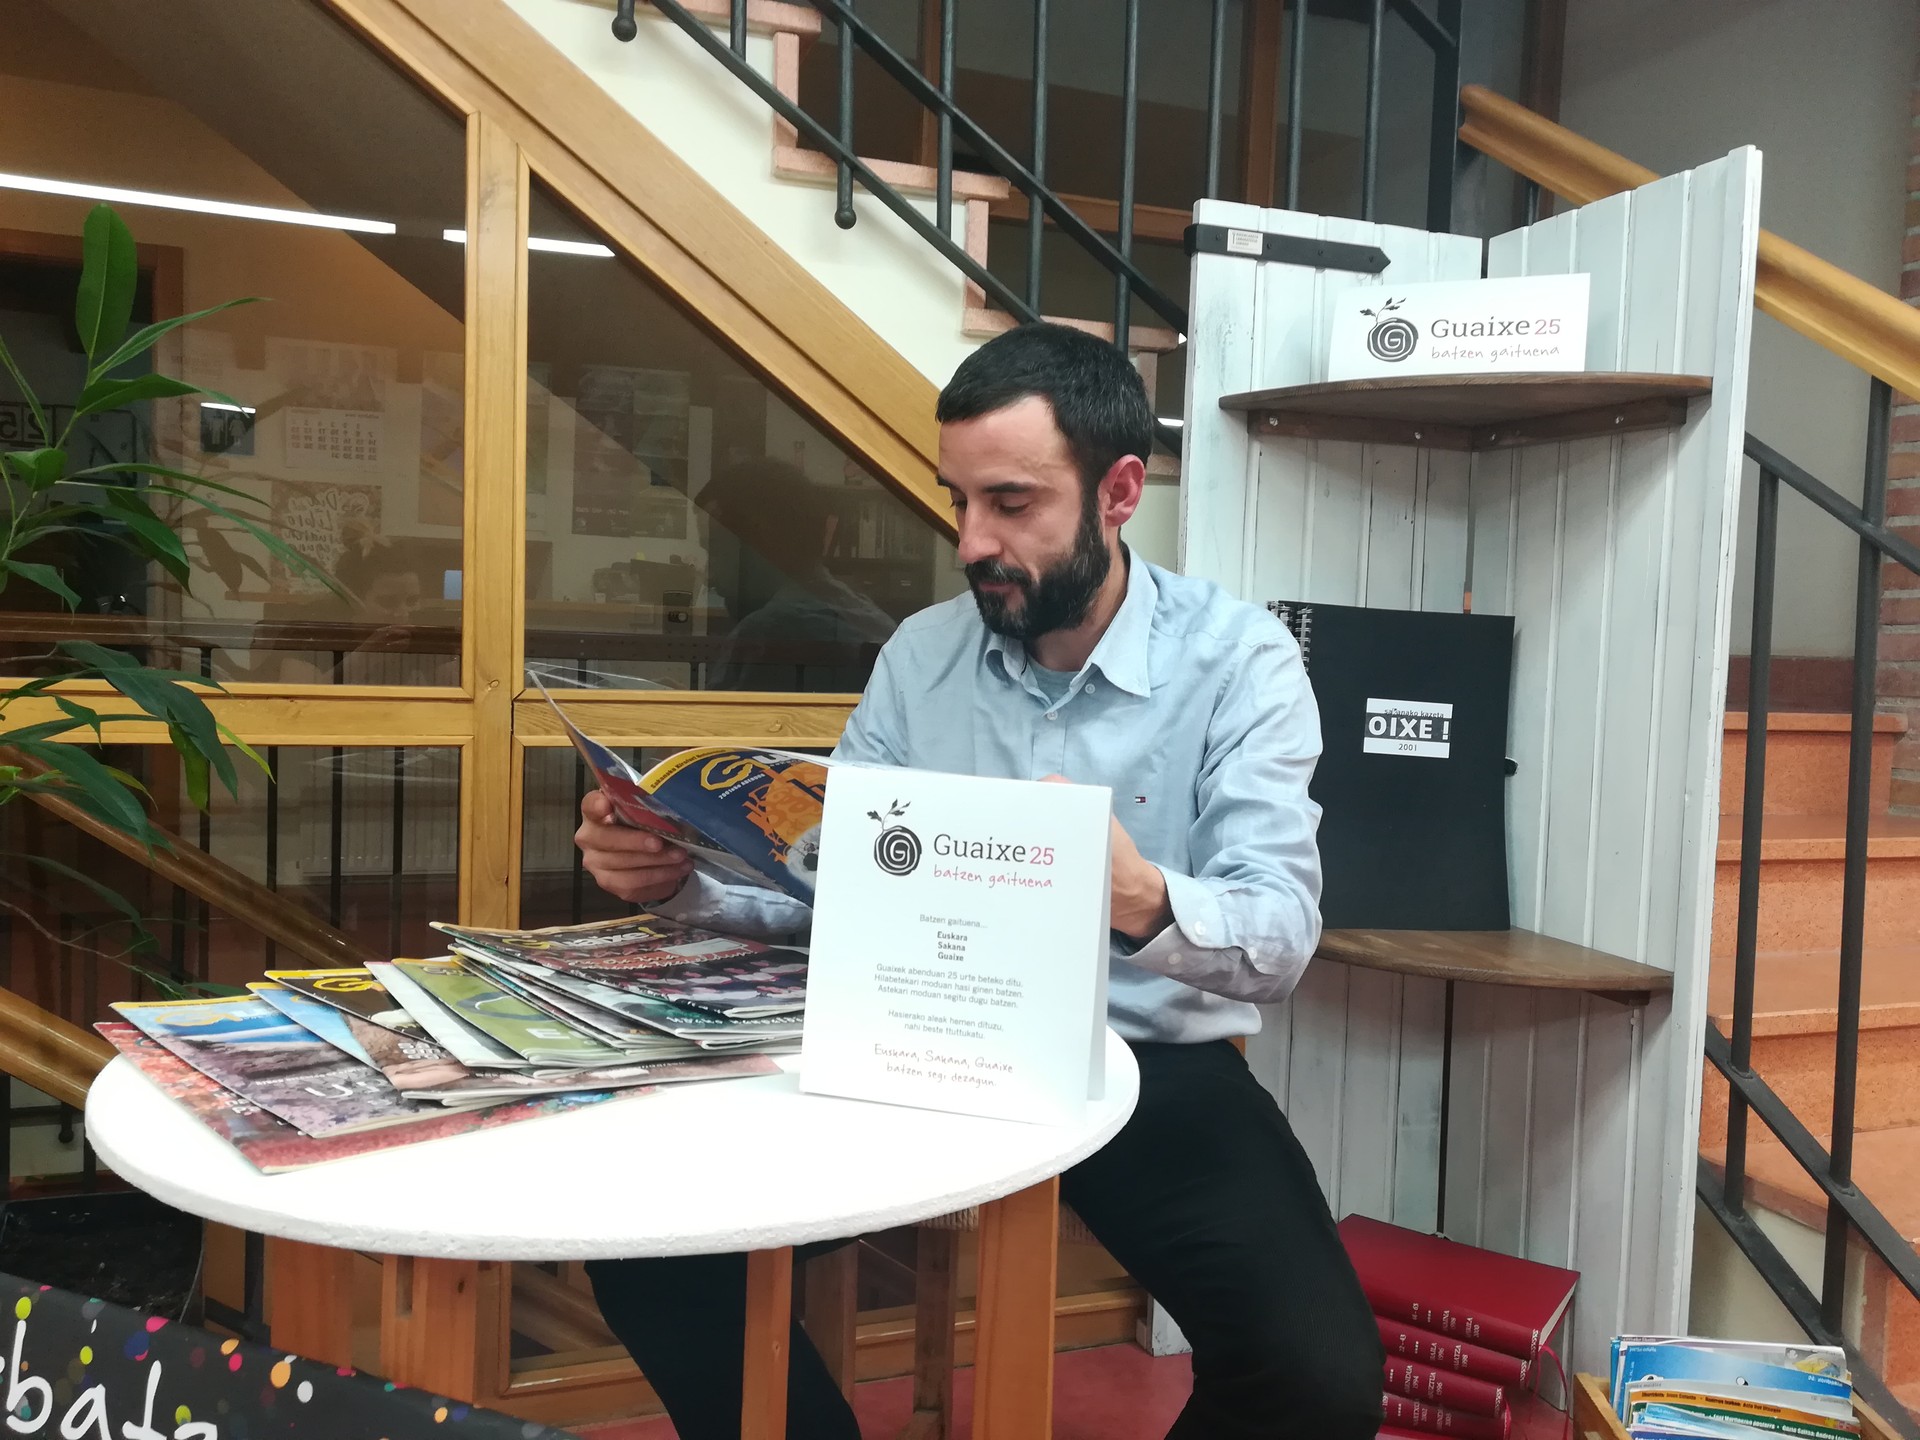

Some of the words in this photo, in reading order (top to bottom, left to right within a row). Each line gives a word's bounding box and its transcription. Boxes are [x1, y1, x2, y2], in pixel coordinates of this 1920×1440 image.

[1432, 346, 1484, 359] batzen
[1490, 343, 1560, 363] gaituena
[1420, 709, 1444, 718] kazeta
[1368, 716, 1433, 739] OIXE
[934, 864, 982, 882] batzen
[988, 871, 1053, 888] gaituena
[920, 914, 946, 925] Batzen
[937, 931, 968, 942] Euskara
[938, 942, 966, 951] Sakana
[938, 951, 964, 962] Guaixe
[876, 963, 906, 974] Guaixek
[908, 966, 946, 978] abenduan
[947, 971, 958, 979] 25
[960, 973, 976, 982] urte
[978, 974, 1004, 985] beteko
[874, 973, 920, 986] Hilabetekari
[921, 979, 953, 990] moduan
[954, 982, 971, 992] hasi
[972, 985, 994, 995] ginen
[877, 984, 909, 996] Astekari
[910, 988, 942, 999] moduan
[943, 991, 967, 1003] segitu
[968, 994, 989, 1005] dugu
[888, 1009, 926, 1021] Hasierako
[927, 1013, 947, 1024] aleak
[950, 1016, 976, 1027] hemen
[904, 1021, 921, 1031] nahi
[922, 1024, 944, 1034] beste
[886, 1062, 923, 1077] batzen
[975, 1056, 1013, 1074] Guaixe
